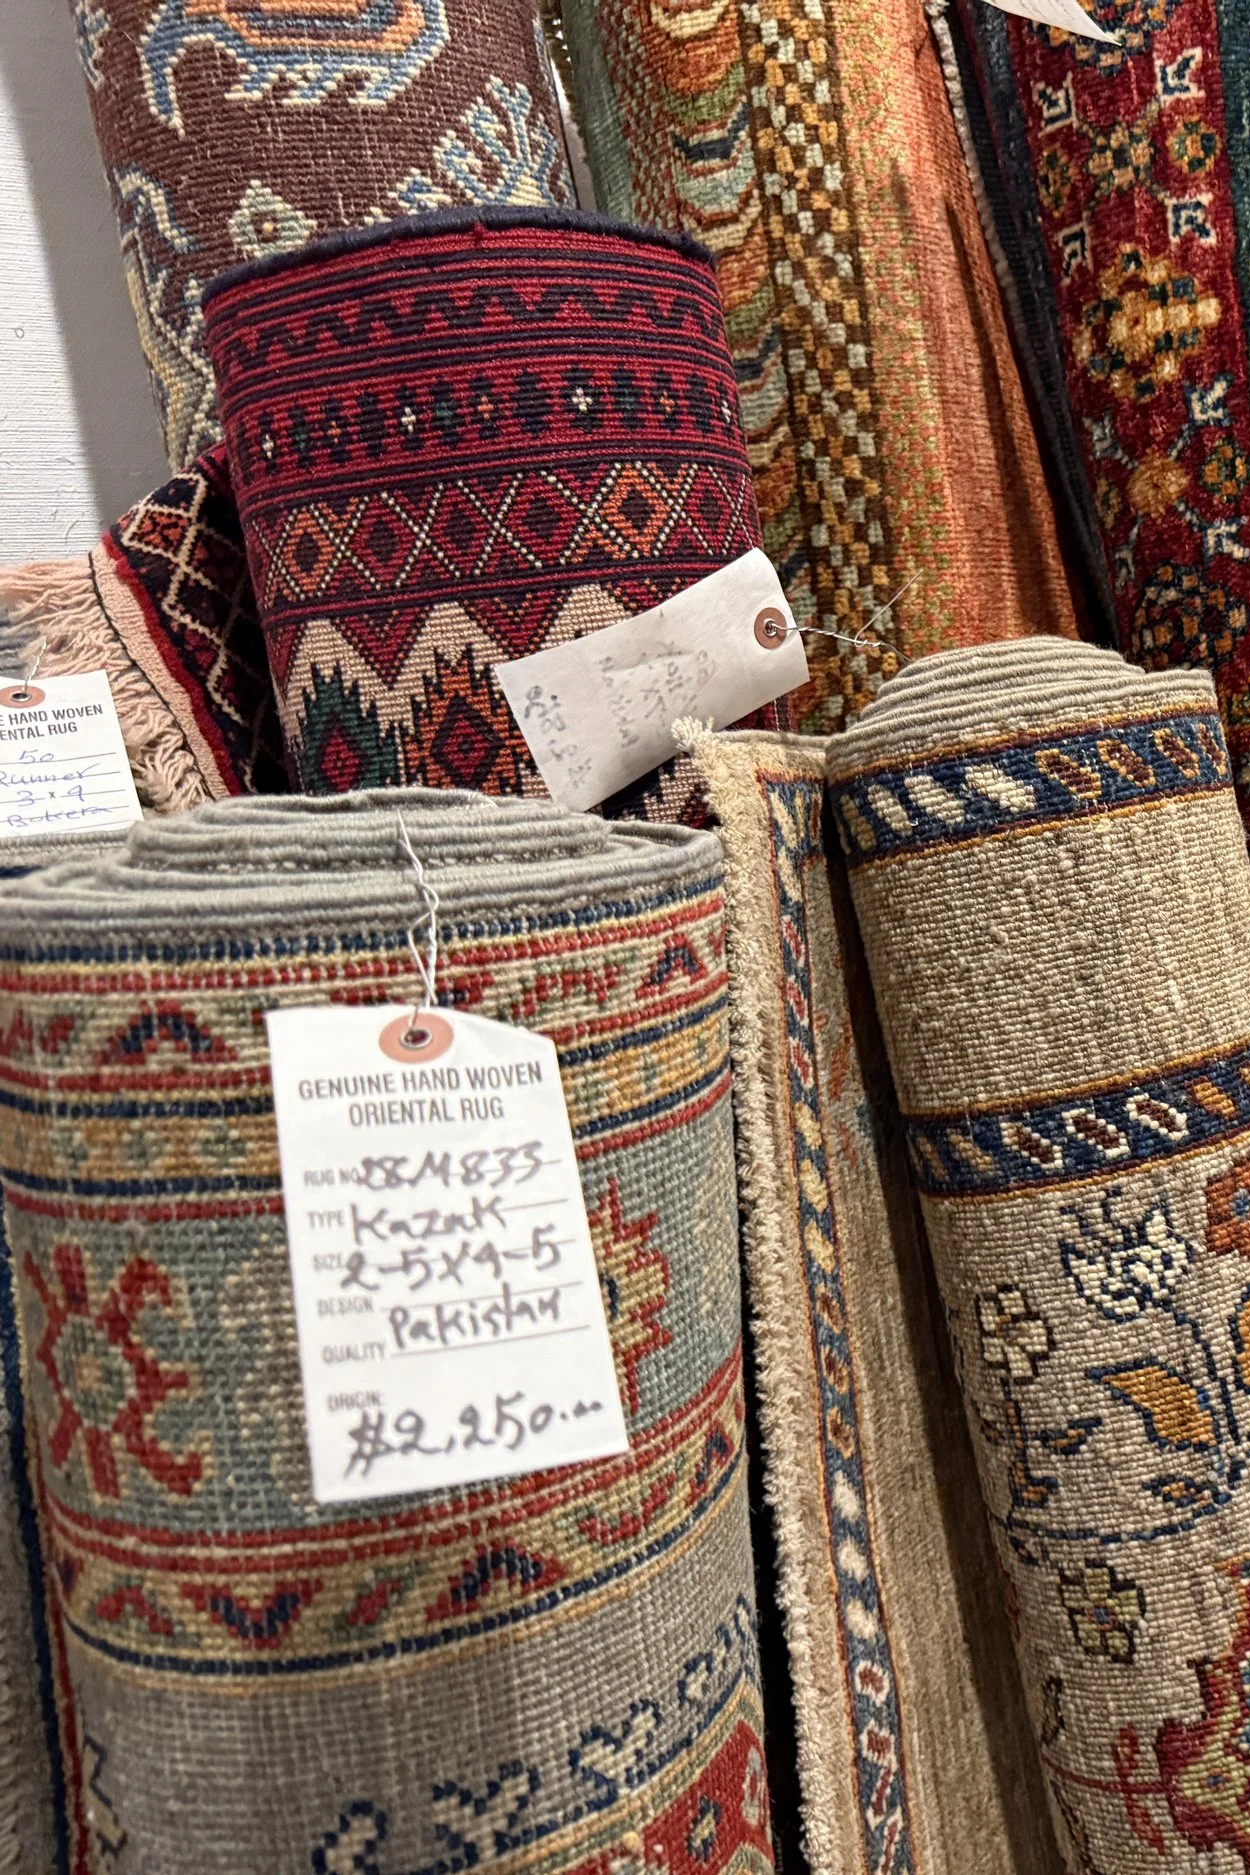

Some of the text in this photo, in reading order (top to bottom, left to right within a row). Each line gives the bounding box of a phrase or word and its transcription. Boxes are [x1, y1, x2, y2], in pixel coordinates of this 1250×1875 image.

[8, 709, 49, 726] HAND
[51, 704, 104, 721] WOVEN
[0, 721, 78, 741] ENTAL RUG
[18, 749, 55, 765] 50
[17, 790, 35, 807] 3
[298, 1060, 543, 1102] GENUINE HAND WOVEN
[348, 1096, 505, 1128] ORIENTAL RUG
[303, 1169, 336, 1187] RUG
[308, 1210, 345, 1230] TYPE
[313, 1252, 345, 1271] SIZE
[318, 1296, 374, 1317] DESIGN
[322, 1341, 386, 1365] QUALITY
